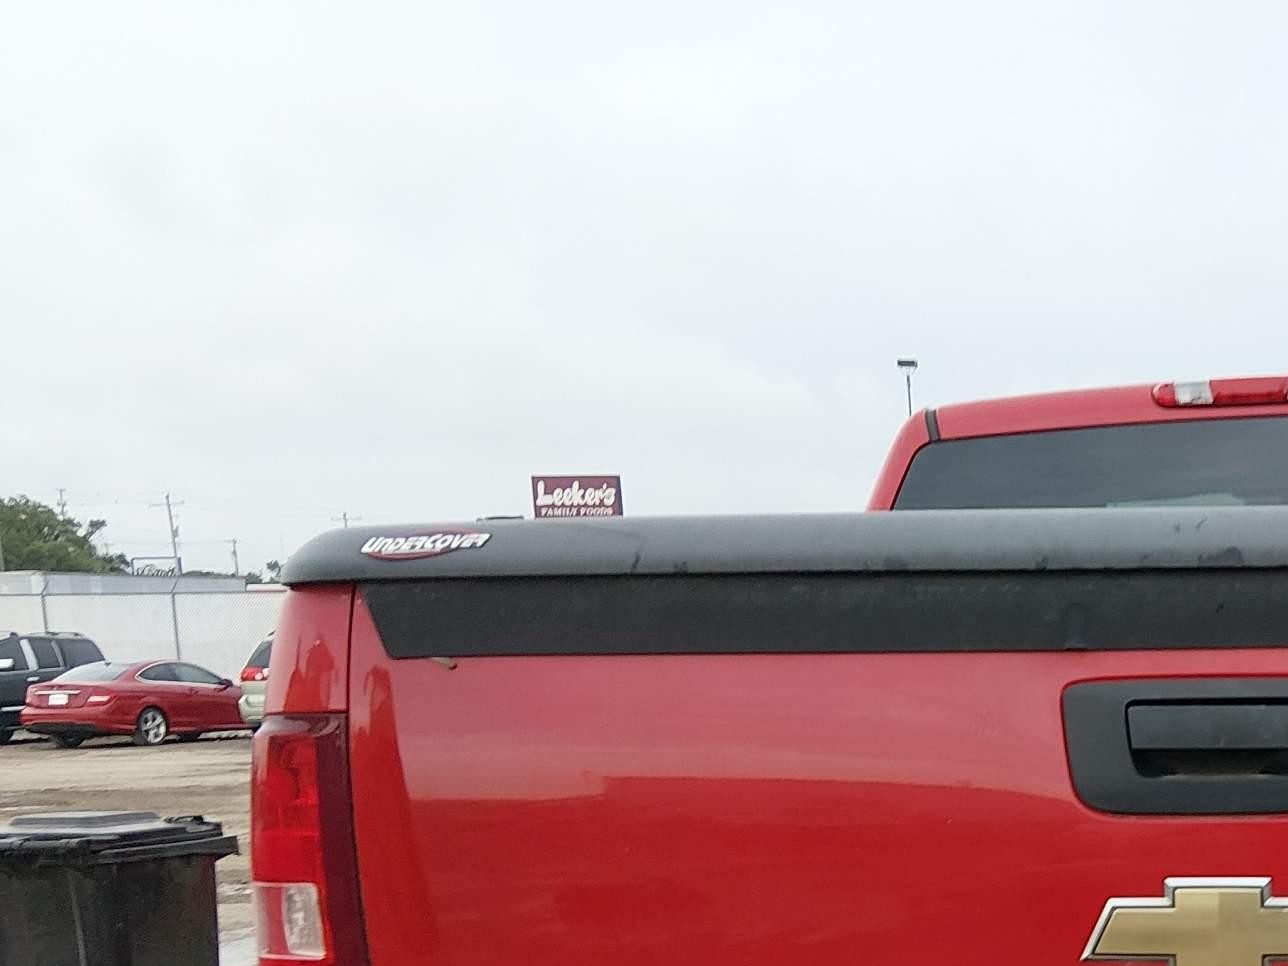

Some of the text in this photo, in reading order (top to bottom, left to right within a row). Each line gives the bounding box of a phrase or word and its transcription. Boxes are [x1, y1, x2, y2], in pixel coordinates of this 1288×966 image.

[536, 480, 616, 506] Leeker's
[541, 506, 578, 517] FAMILY
[361, 533, 491, 554] UNDERCOVER
